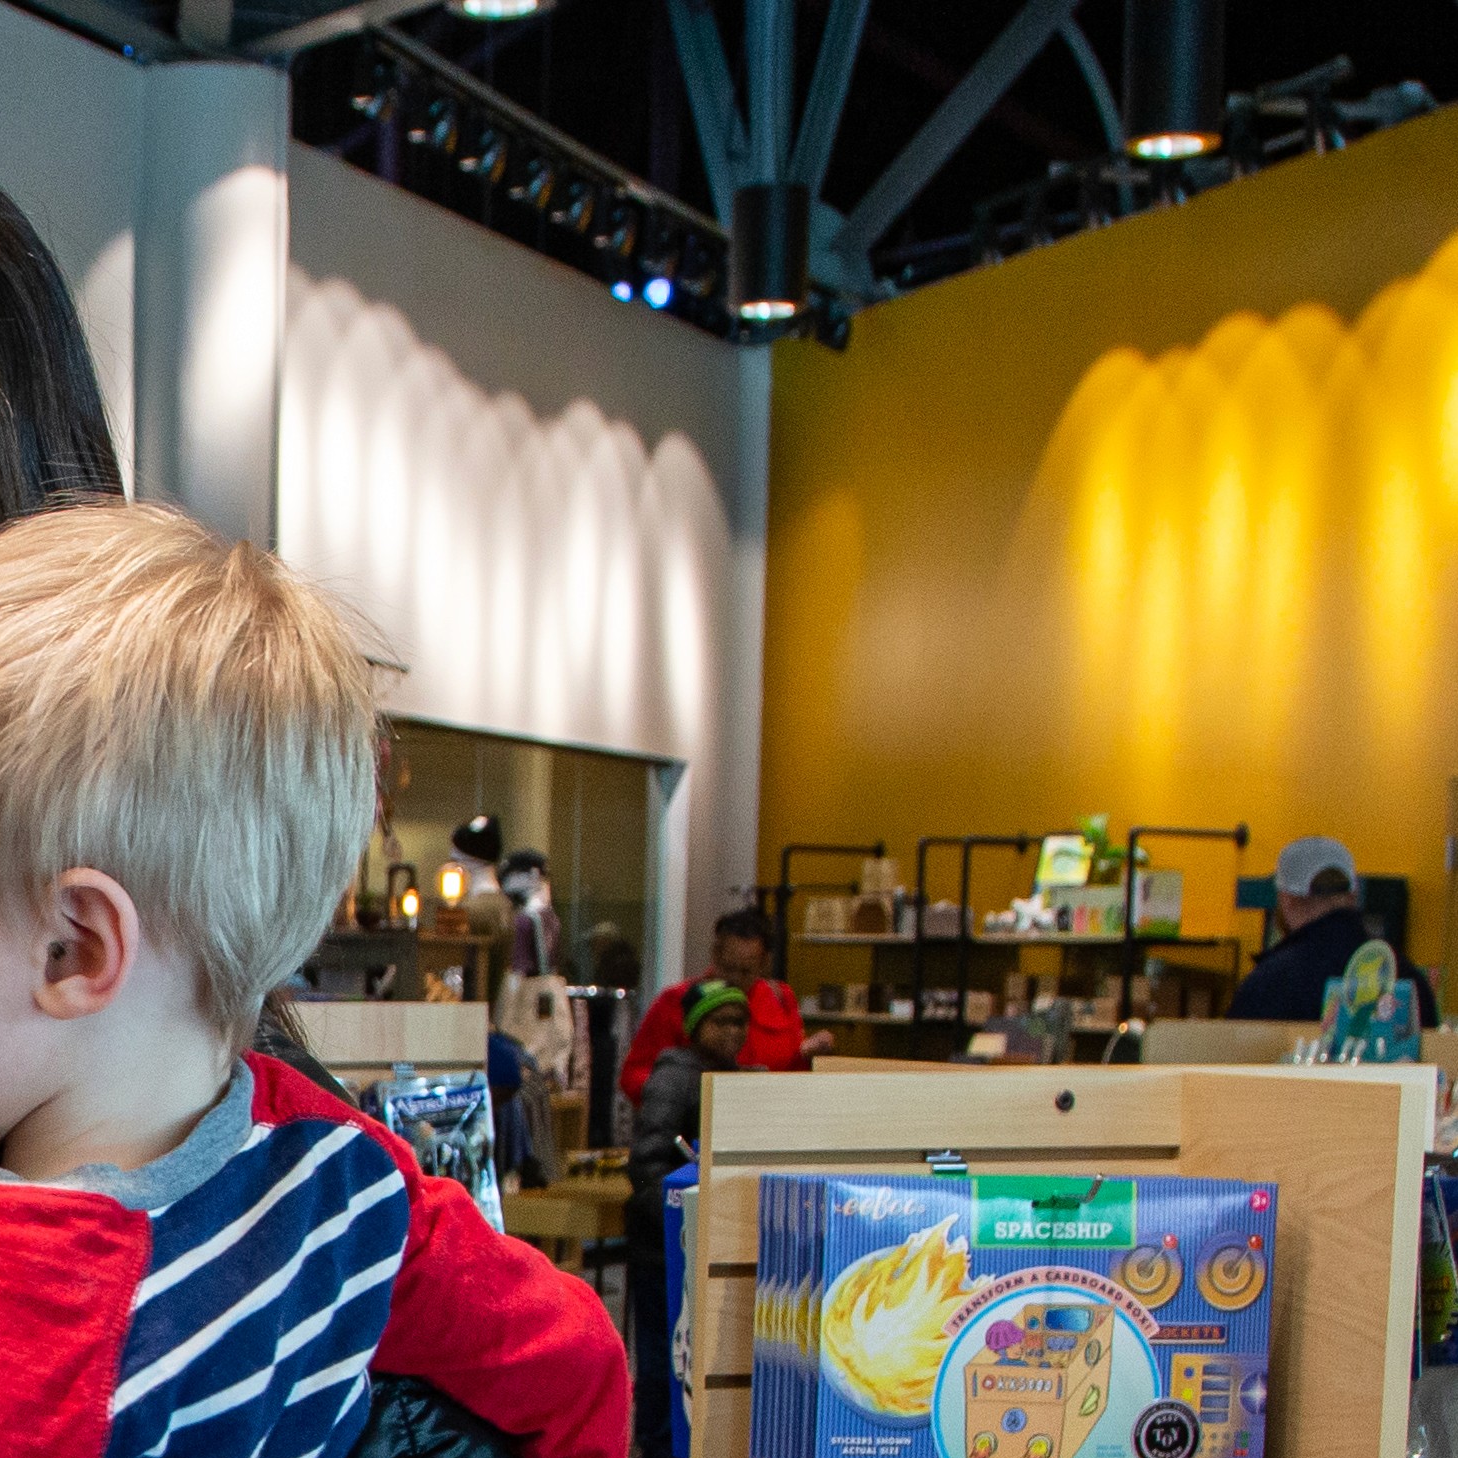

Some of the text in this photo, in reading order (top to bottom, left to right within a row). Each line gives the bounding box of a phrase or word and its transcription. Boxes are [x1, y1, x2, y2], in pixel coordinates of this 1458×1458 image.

[994, 1220, 1115, 1242] SPACESHIP
[951, 1276, 1025, 1328] TRANSFORM
[1030, 1272, 1040, 1282] A
[1044, 1270, 1124, 1302] CARDBOARD
[831, 1436, 912, 1446] STICKERS SHOWN
[1152, 1427, 1182, 1448] TOY
[842, 1446, 901, 1455] ACTUAL SIZE
